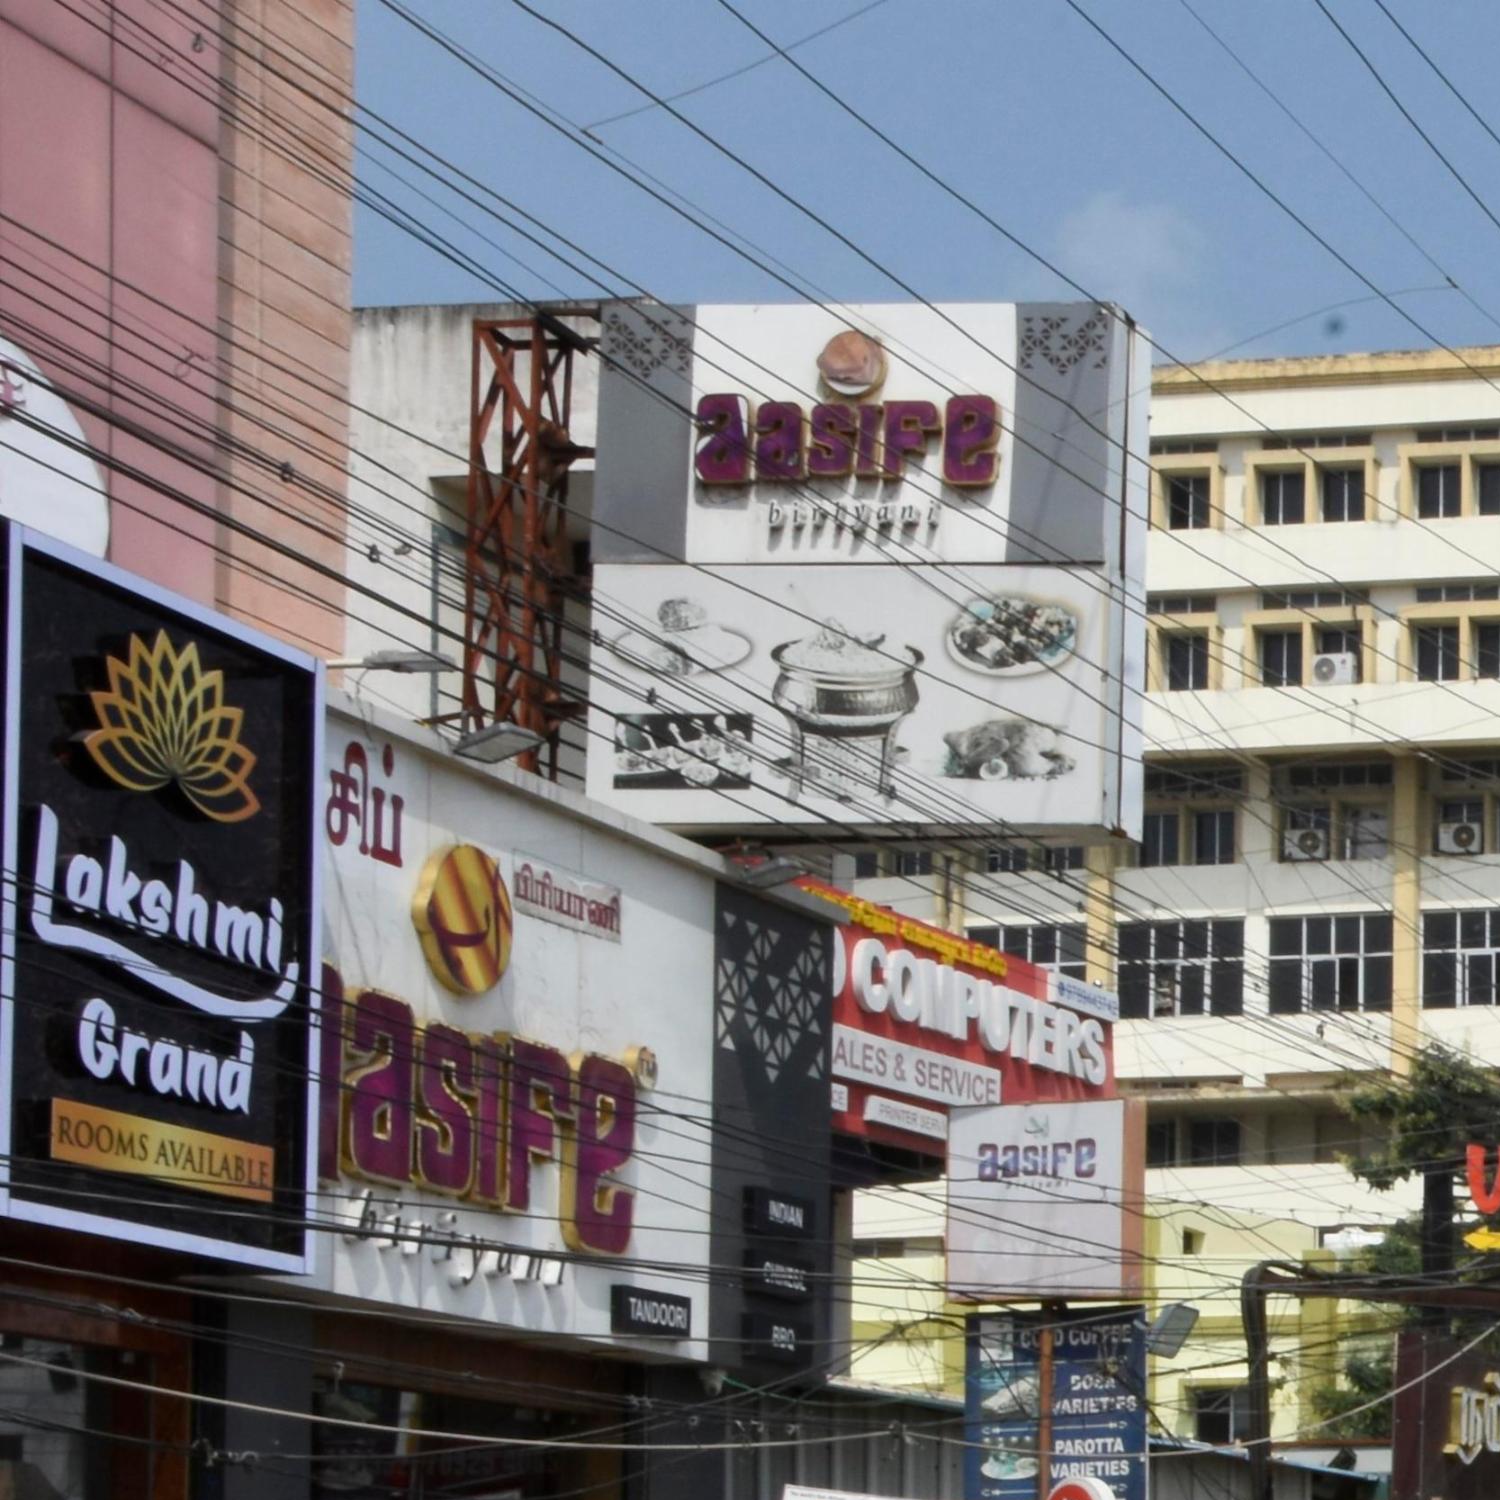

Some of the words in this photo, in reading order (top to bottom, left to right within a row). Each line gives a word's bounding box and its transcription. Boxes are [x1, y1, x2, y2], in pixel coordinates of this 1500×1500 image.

[766, 500, 938, 538] biriyani
[32, 804, 298, 1022] Lakshmi
[512, 863, 622, 935] பிரியாணி
[852, 938, 1106, 1085] COMPUTERS
[79, 998, 254, 1114] Grand
[893, 1050, 907, 1083] &
[914, 1058, 998, 1103] SERVICE
[58, 1115, 149, 1161] ROOMS
[155, 1140, 270, 1188] AVAILABLE
[768, 1200, 803, 1229] INDIAN
[629, 1297, 688, 1329] TANDOORI
[1050, 1460, 1130, 1479] VARIETIES
[1055, 1437, 1124, 1455] PAROTTA
